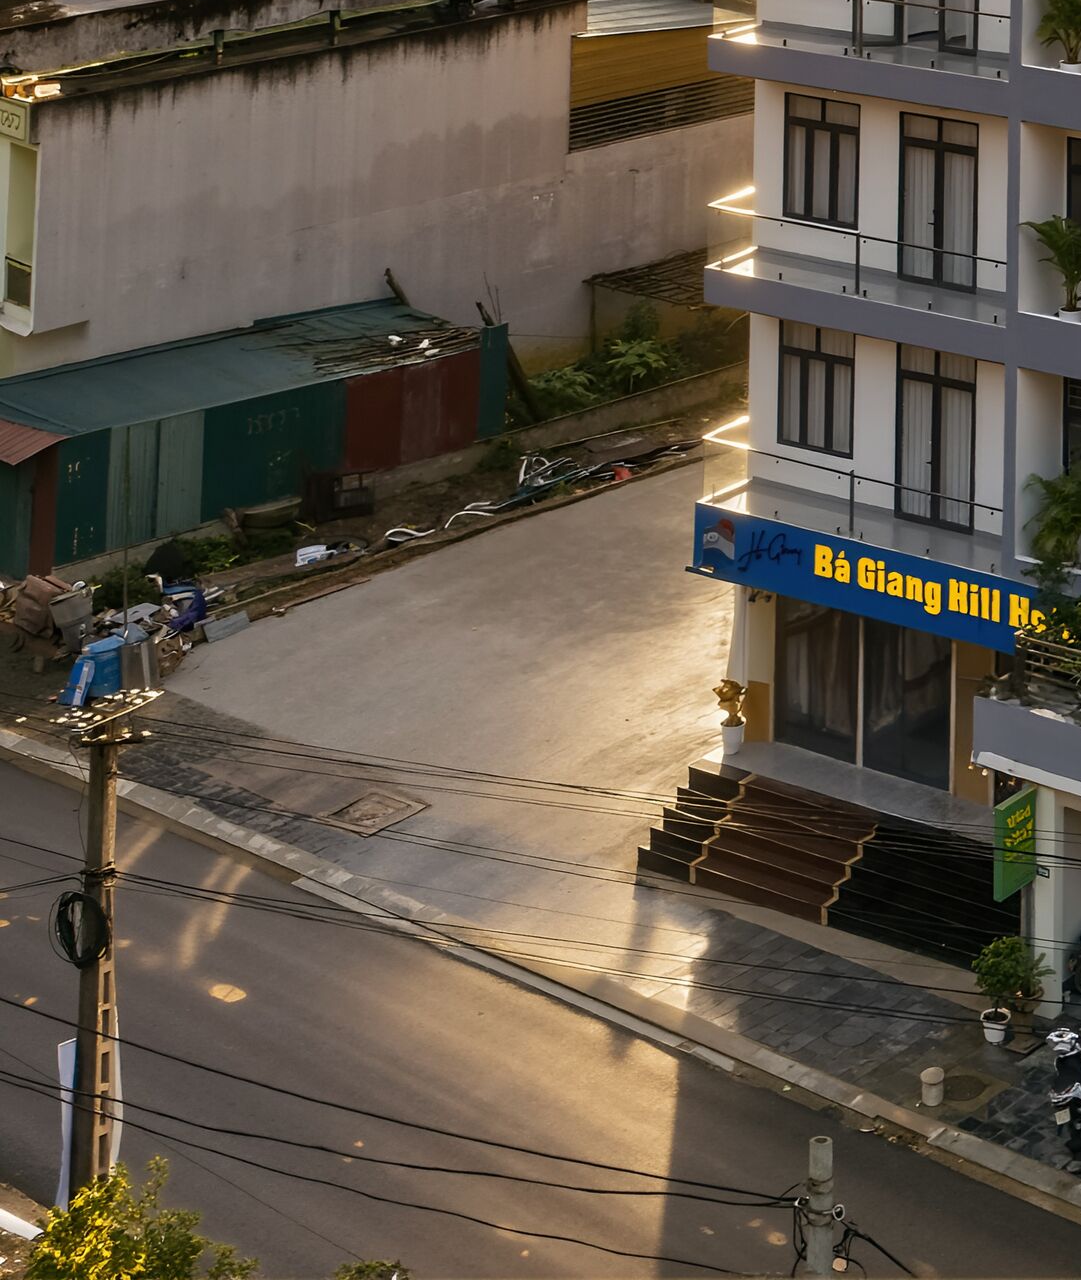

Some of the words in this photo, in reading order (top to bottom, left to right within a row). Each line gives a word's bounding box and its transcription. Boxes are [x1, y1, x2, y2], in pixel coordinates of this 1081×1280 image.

[814, 544, 851, 584] Bá
[857, 557, 942, 615] Giang
[948, 578, 1001, 624] Hill
